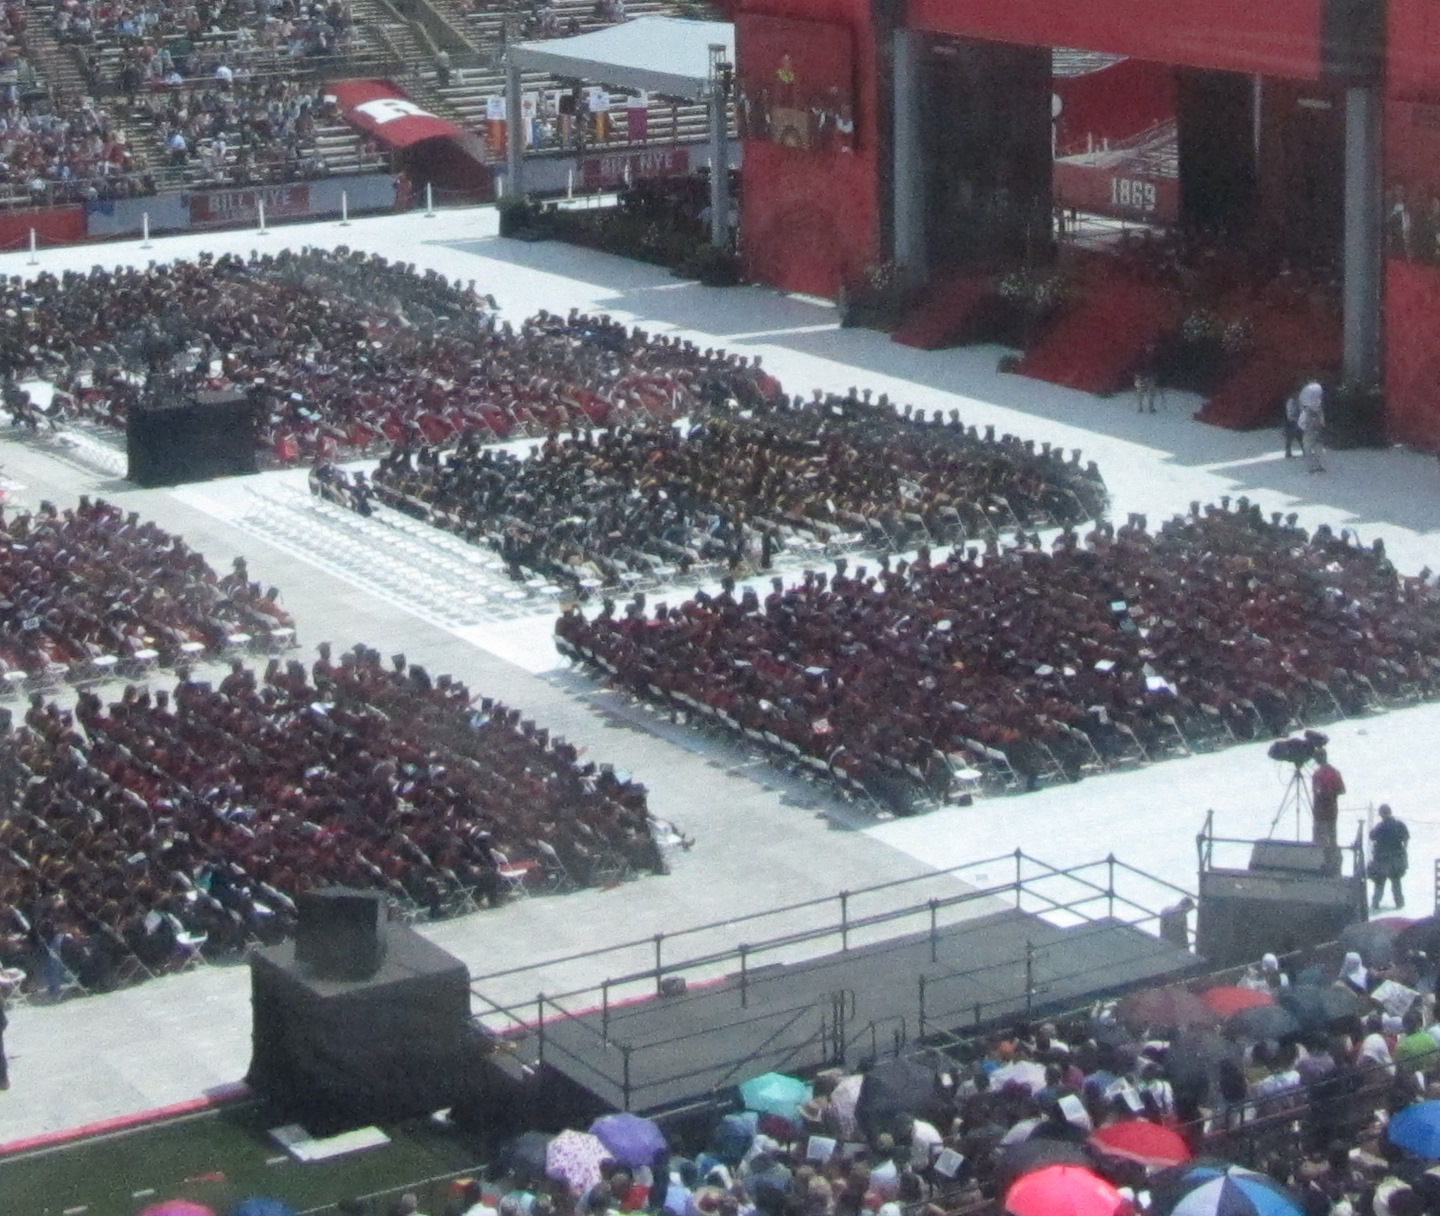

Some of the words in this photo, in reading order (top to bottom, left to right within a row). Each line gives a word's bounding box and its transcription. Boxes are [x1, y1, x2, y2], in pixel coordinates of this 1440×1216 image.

[208, 192, 249, 214] BILL
[254, 187, 292, 208] NYE
[1111, 177, 1157, 211] 1869
